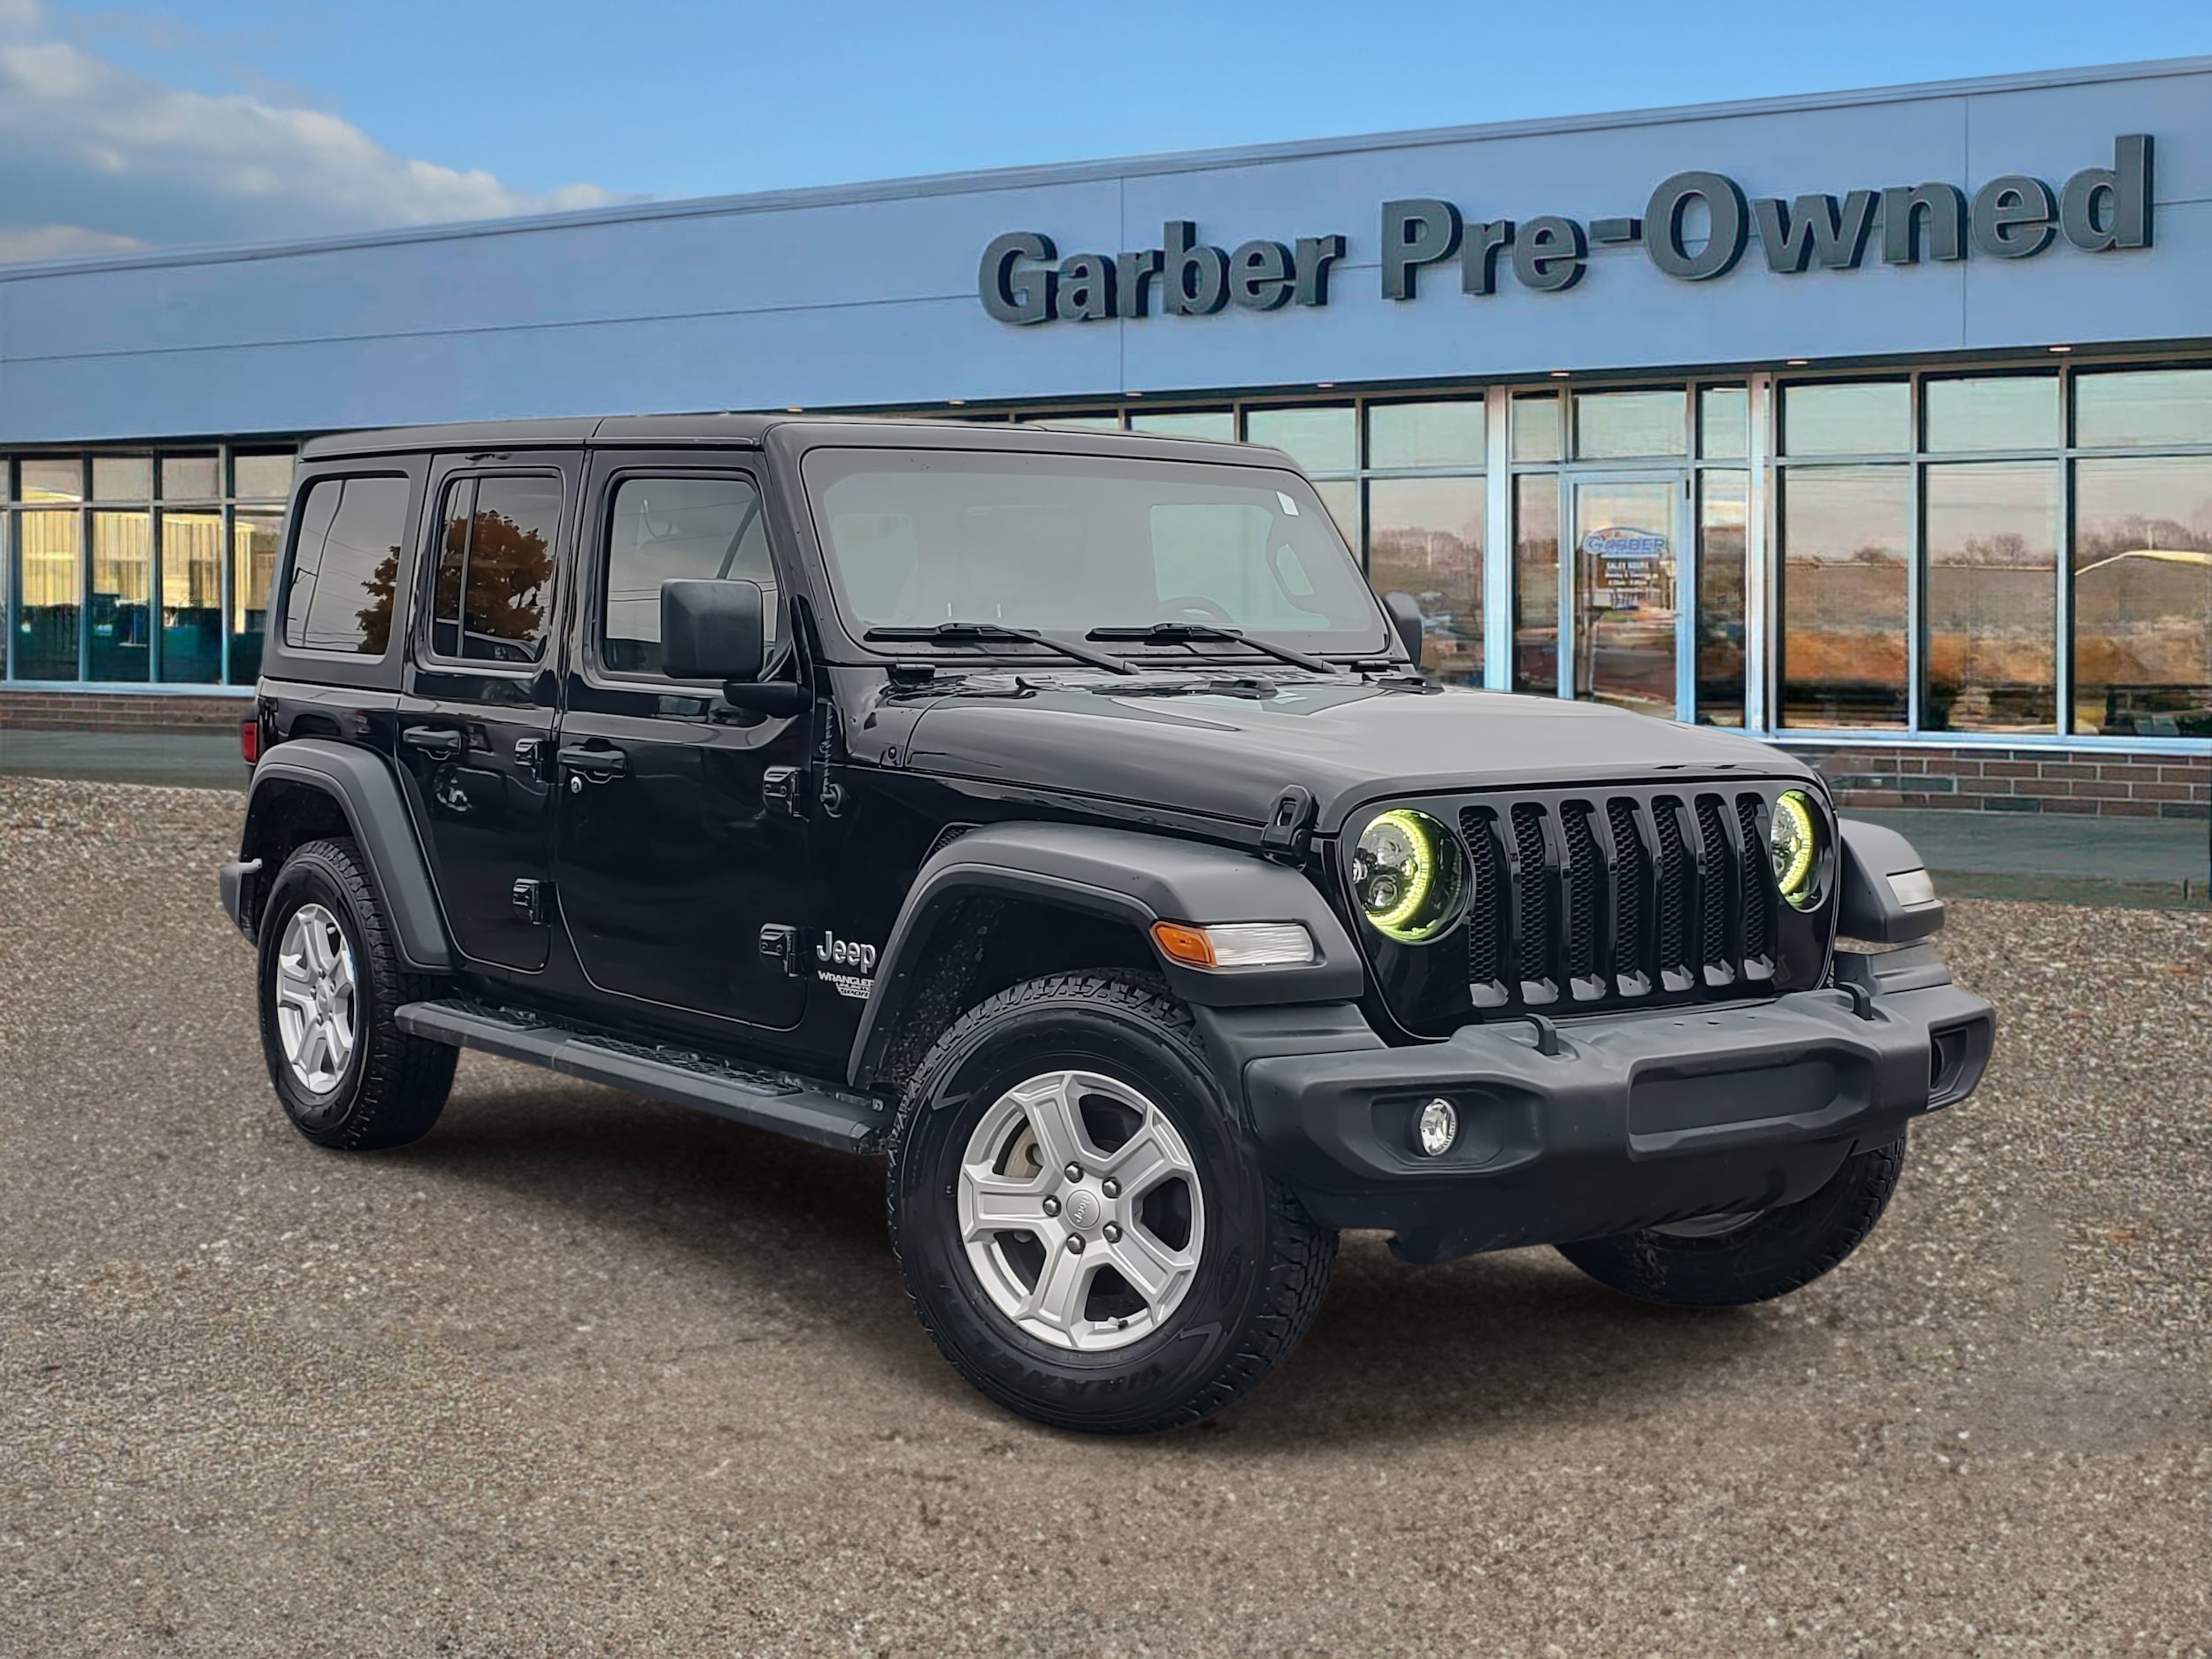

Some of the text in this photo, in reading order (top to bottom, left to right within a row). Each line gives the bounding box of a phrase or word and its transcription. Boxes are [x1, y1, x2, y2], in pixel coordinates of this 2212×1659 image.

[979, 134, 2154, 325] Garber Pre-Owned
[817, 930, 876, 974] Jeep
